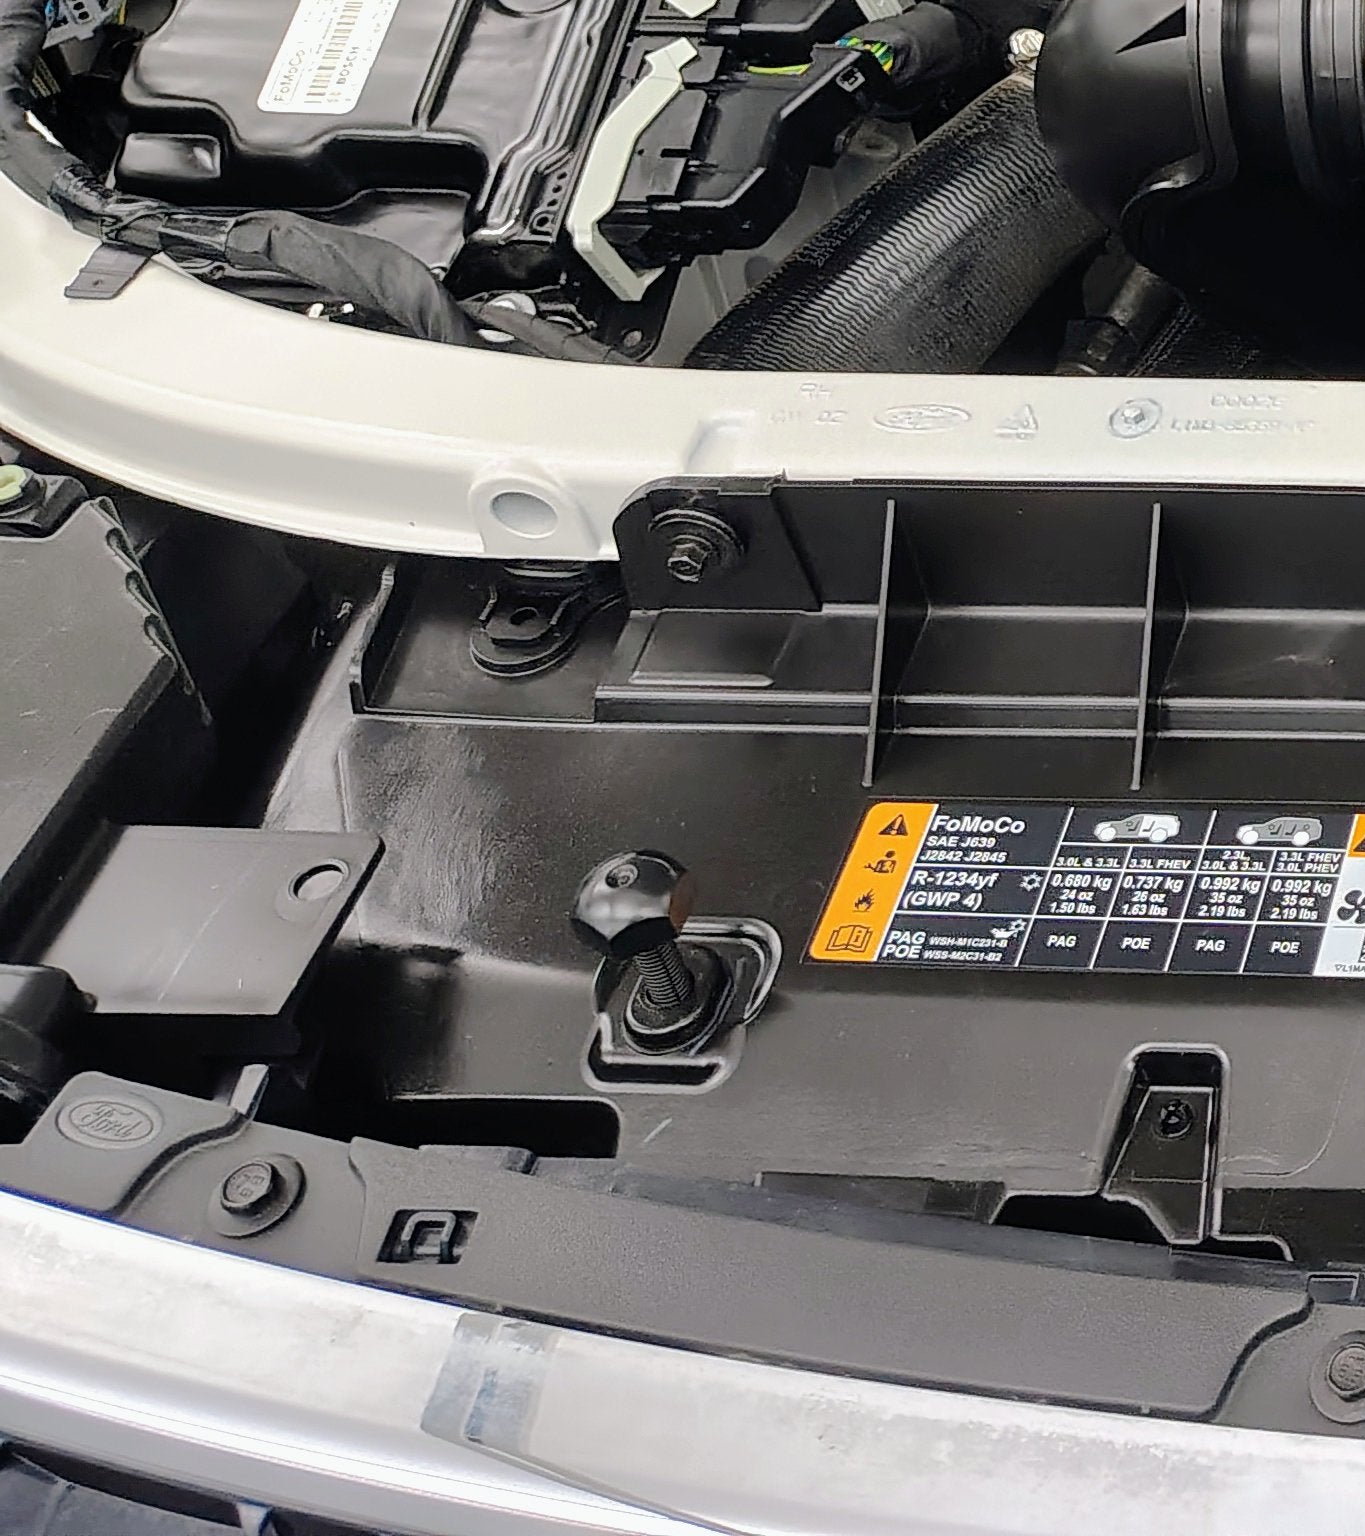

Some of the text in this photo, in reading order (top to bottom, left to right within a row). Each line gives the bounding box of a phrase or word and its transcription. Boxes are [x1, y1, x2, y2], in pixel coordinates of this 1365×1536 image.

[931, 814, 1026, 834] FoMoCo
[926, 835, 997, 849] SAE J639
[920, 850, 1008, 863] J2842 J2845
[1055, 856, 1121, 868] 3.0L & 3.3L
[1278, 851, 1342, 863] 3.3L FHEV
[1128, 858, 1192, 870] 3.3L FHEV
[1201, 860, 1267, 872] 3.0L & 3.3L
[1275, 862, 1339, 873] 3.0L PHEV
[910, 870, 1000, 891] R-1234yf
[1050, 873, 1113, 891] 0.680 kg
[1122, 875, 1185, 893] 0.737 kg
[1200, 876, 1262, 894] 0.992 kg
[1270, 878, 1333, 898] 0.992 kg
[901, 891, 983, 911] (GWP 4)
[1059, 889, 1095, 901] 24 oz
[1131, 890, 1167, 903] 26 oz
[1208, 892, 1244, 904] 35 oz
[1280, 894, 1315, 907] 35 oz
[1049, 902, 1097, 914] 1.50 lbs
[1121, 904, 1169, 916] 1.63 lbs
[1198, 905, 1247, 917] 2.19 lbs
[1270, 907, 1319, 920] 2.19 lbs
[887, 930, 927, 944] PAG
[1046, 934, 1077, 948] PAG
[1120, 936, 1152, 950] POE
[881, 944, 923, 959] POE
[1194, 938, 1226, 952] PAG
[1268, 941, 1301, 954] POE
